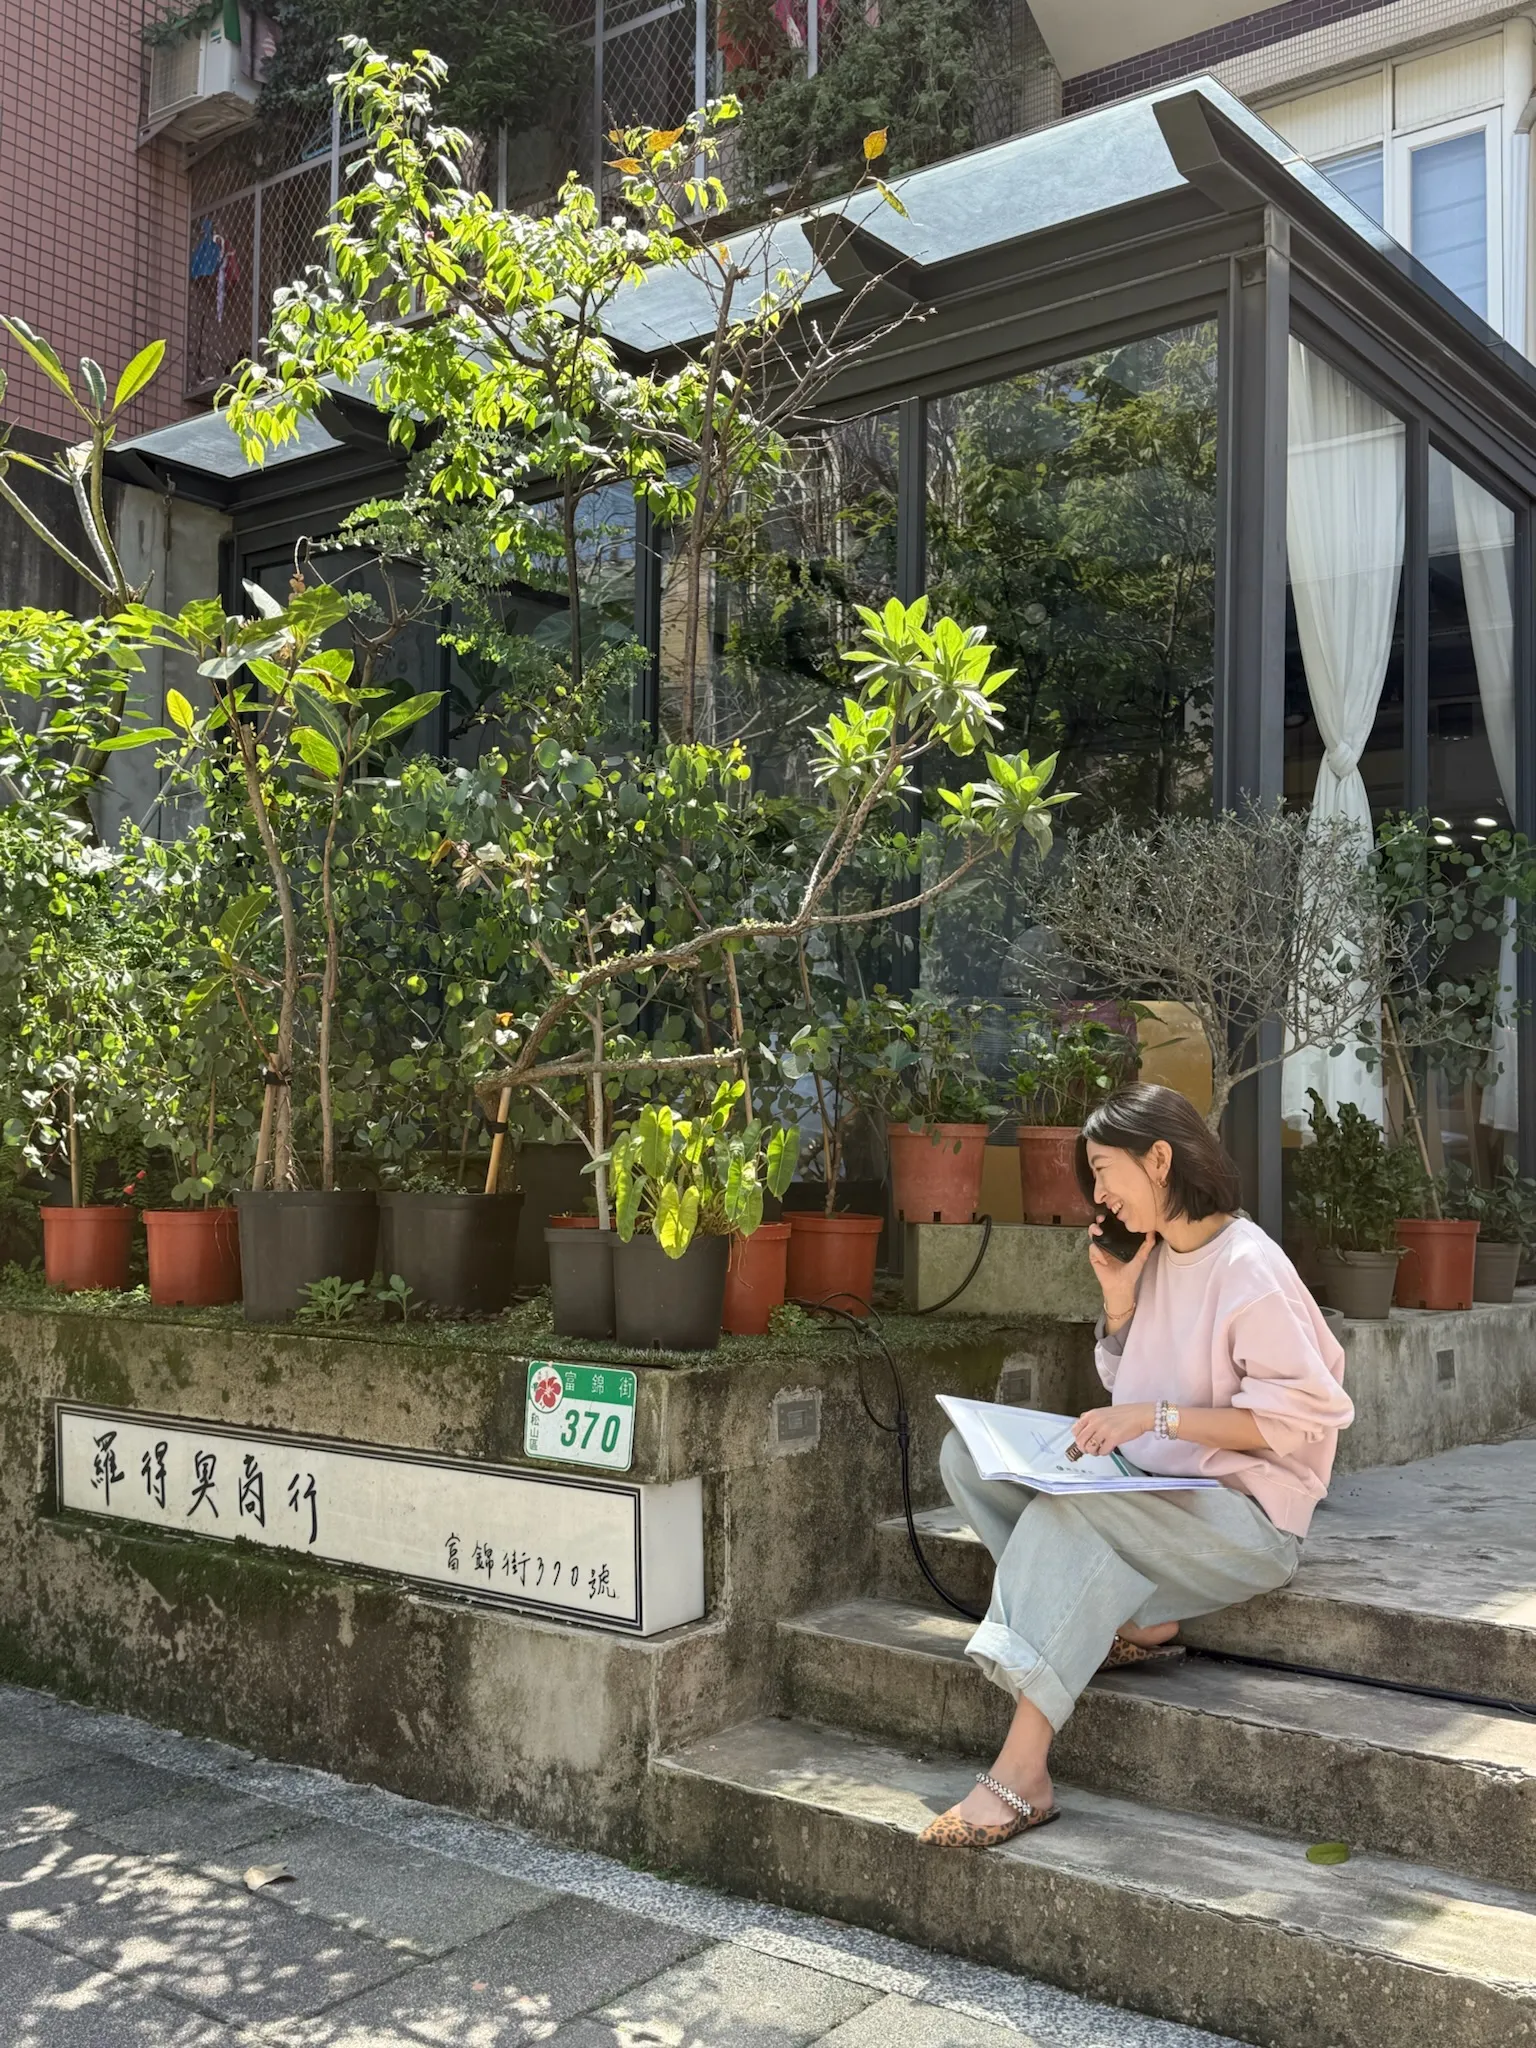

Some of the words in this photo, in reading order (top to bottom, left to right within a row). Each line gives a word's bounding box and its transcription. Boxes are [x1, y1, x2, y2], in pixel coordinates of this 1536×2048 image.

[565, 1370, 633, 1399] 富錦街
[560, 1409, 621, 1453] 370
